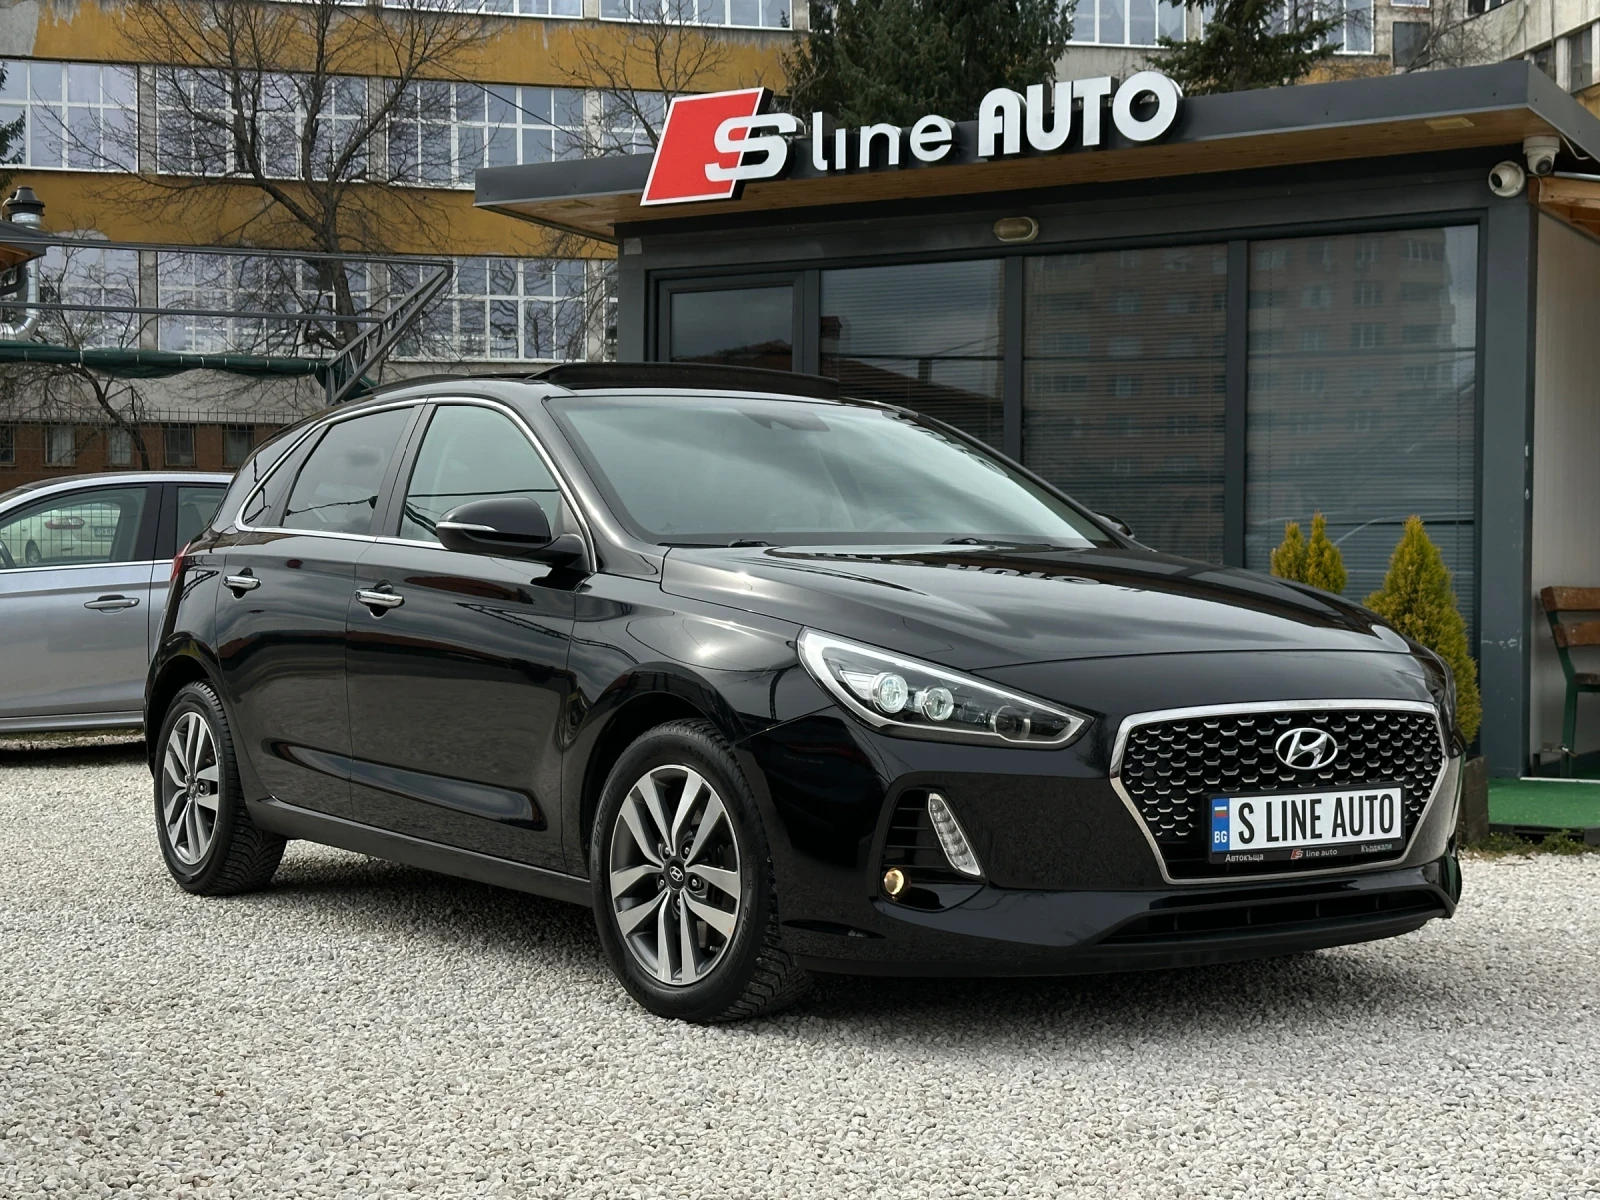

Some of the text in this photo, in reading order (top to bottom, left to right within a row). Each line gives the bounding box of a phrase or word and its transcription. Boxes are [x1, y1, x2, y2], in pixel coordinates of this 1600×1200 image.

[812, 111, 953, 171] line
[978, 71, 1178, 157] AUTO
[1214, 831, 1227, 843] BG
[1238, 794, 1394, 844] S LINE AUTO
